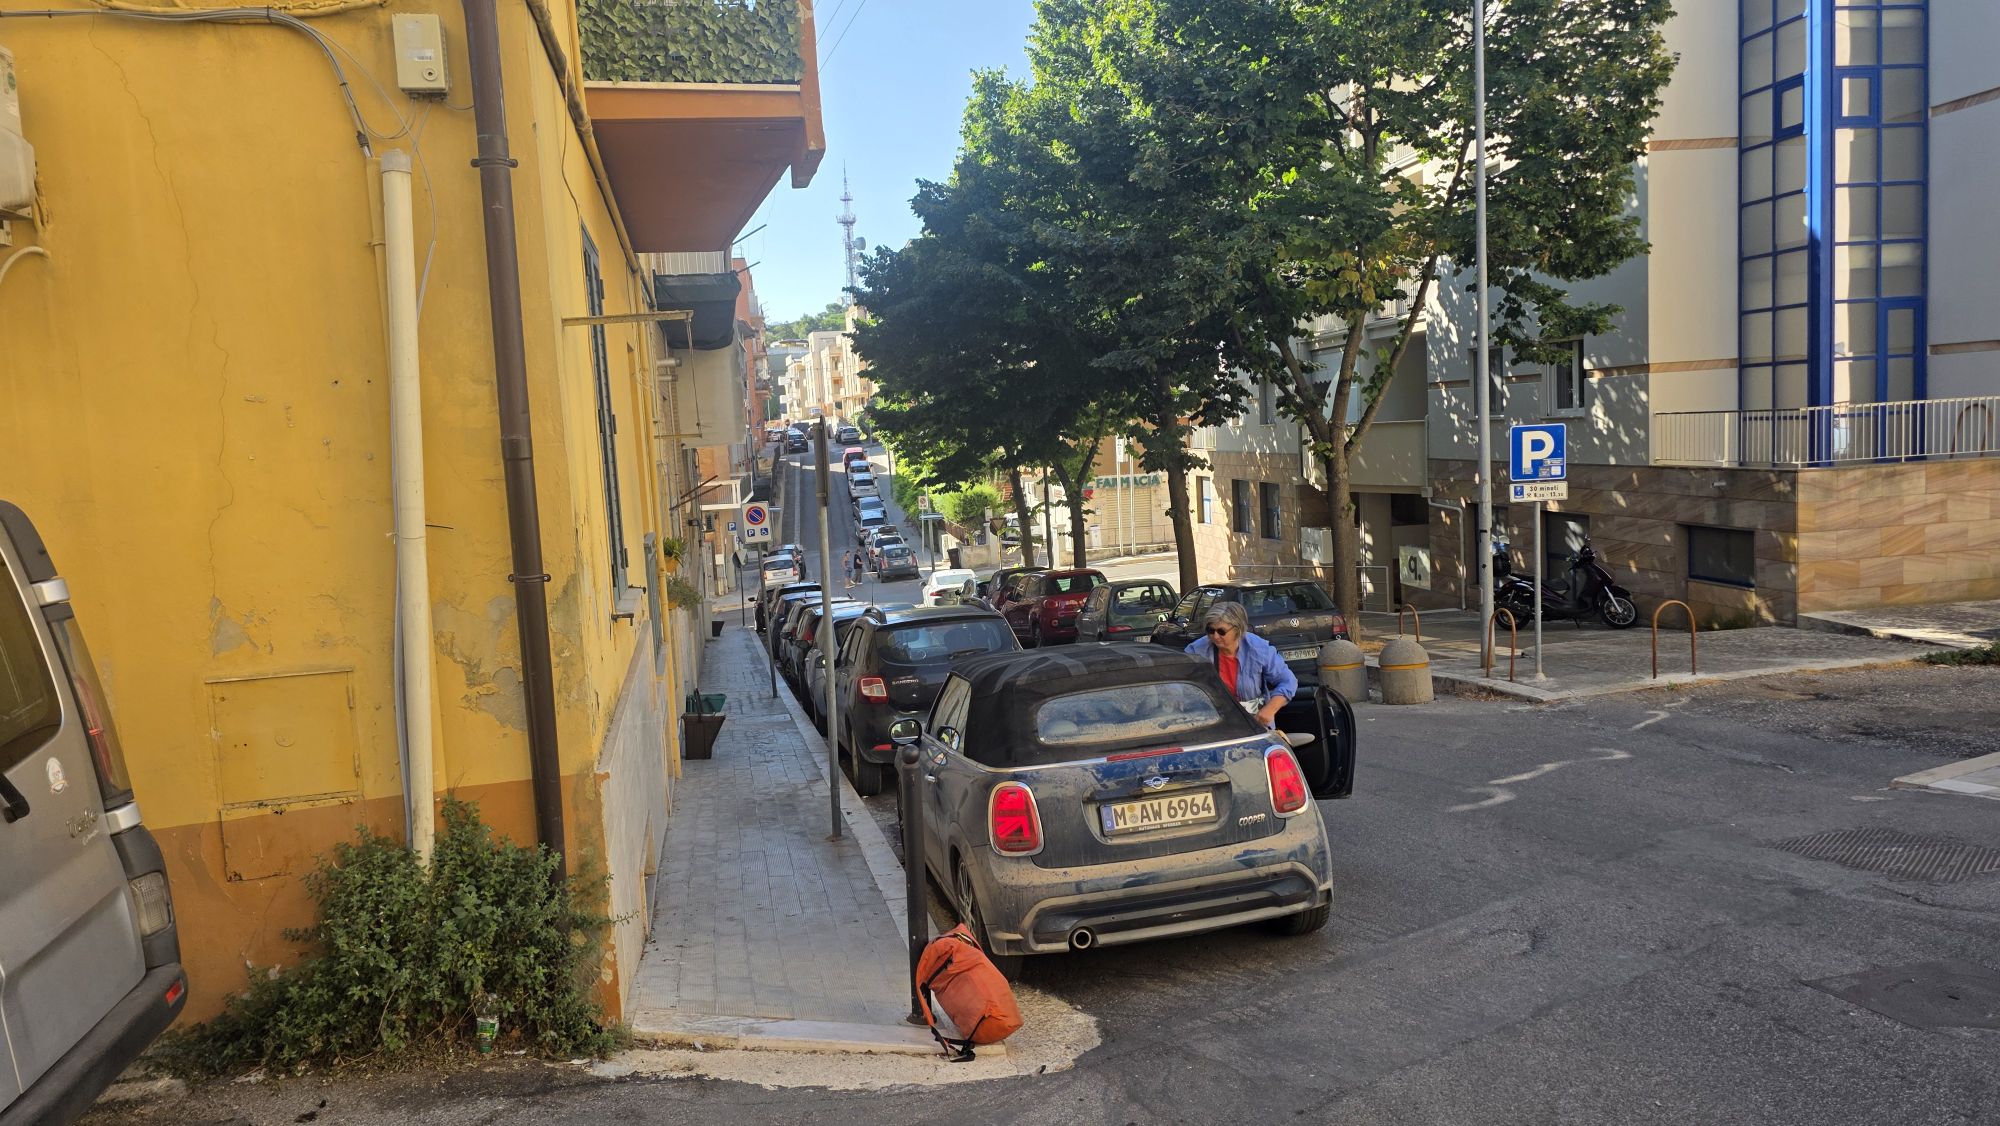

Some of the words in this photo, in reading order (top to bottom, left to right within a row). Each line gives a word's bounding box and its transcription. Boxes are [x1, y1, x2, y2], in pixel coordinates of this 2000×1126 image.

[1522, 430, 1555, 475] P
[1113, 806, 1127, 826] M
[1140, 801, 1163, 823] AW
[1167, 795, 1212, 819] 6964
[1238, 813, 1266, 826] COOPER
